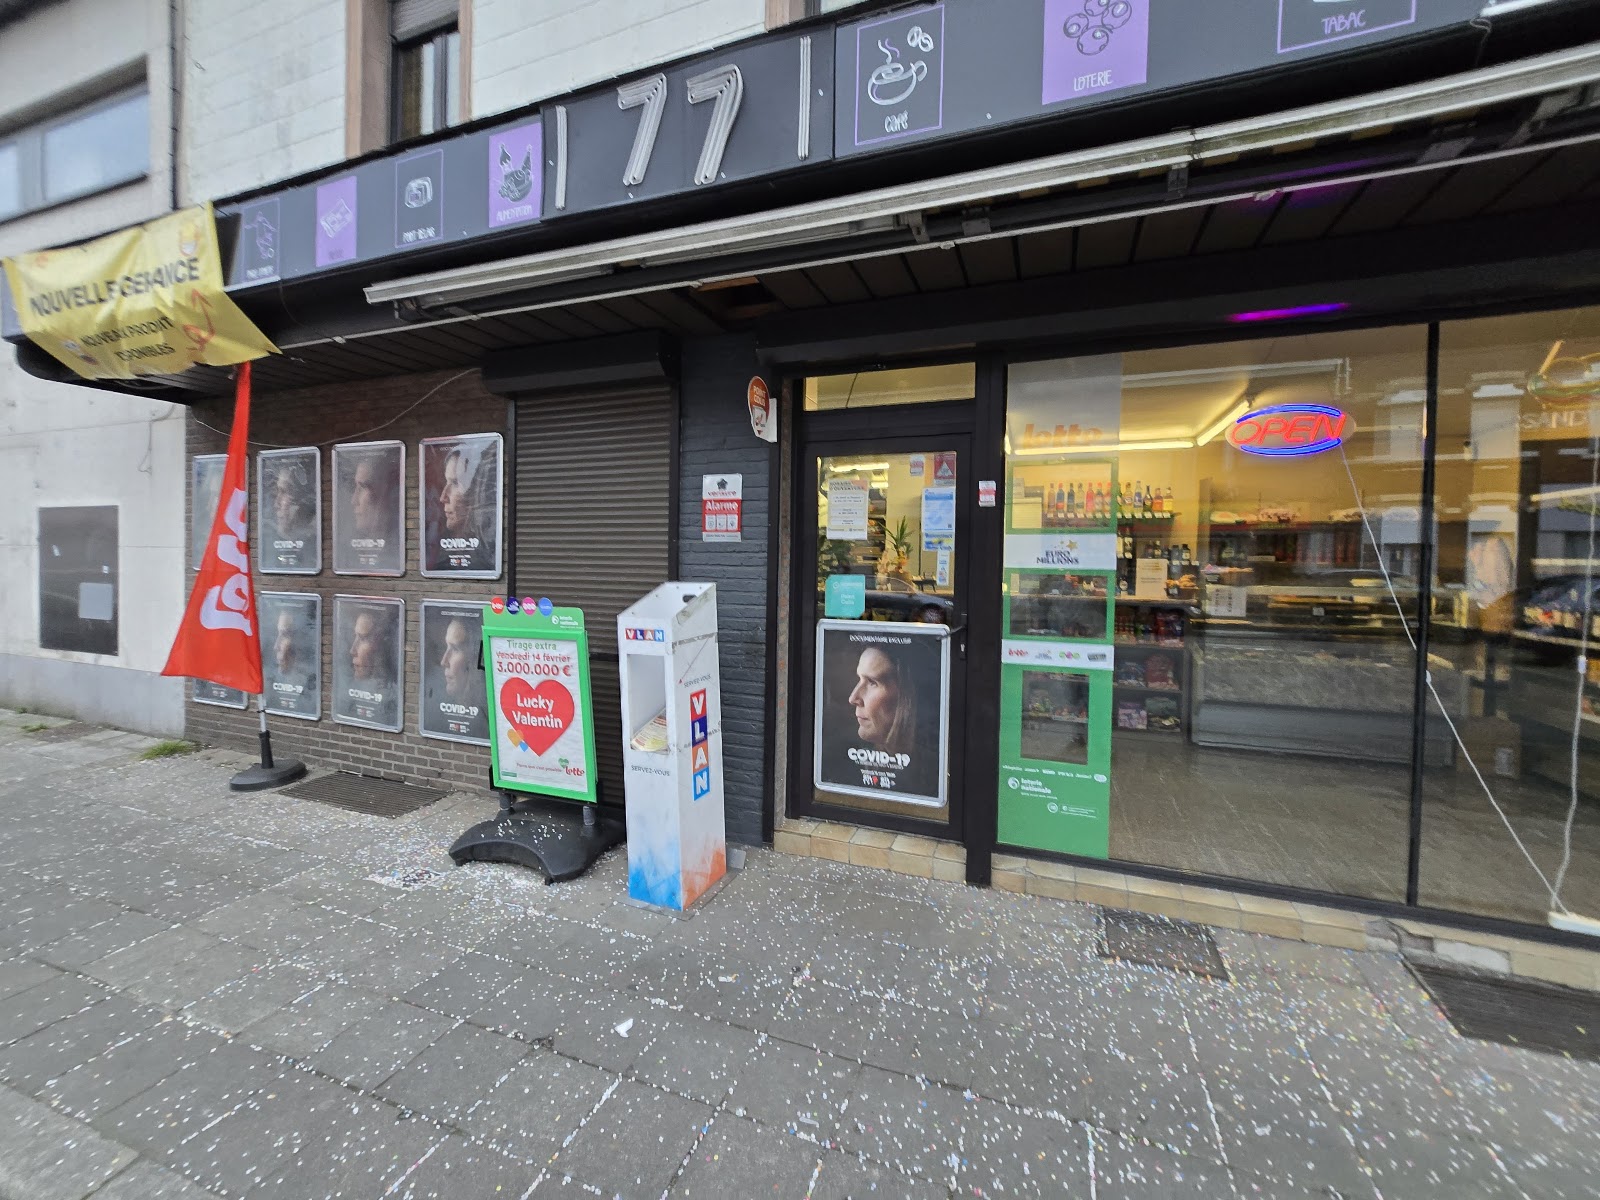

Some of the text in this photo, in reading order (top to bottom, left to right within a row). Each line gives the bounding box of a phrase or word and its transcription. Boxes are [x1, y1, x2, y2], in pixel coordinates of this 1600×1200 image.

[1321, 9, 1366, 34] TABAC
[1073, 69, 1114, 92] LOTERIE
[1231, 412, 1347, 446] OPEN
[273, 540, 304, 549] COVID-19
[351, 539, 386, 548] COVID-19
[440, 537, 480, 550] COVID-19
[626, 629, 664, 641] VLAN
[507, 639, 557, 651] Tirage extra
[496, 651, 571, 662] vendredi 14 février
[497, 661, 559, 676] 3.000.000
[272, 682, 304, 694] COVID-19
[348, 688, 383, 703] COVID-19
[439, 702, 479, 717] COVID-19
[516, 693, 555, 713] Lucky
[511, 710, 563, 729] Valentin
[692, 693, 709, 796] VLAN
[847, 747, 911, 767] COVID-19
[631, 765, 670, 777] SERVEZ-VOUS
